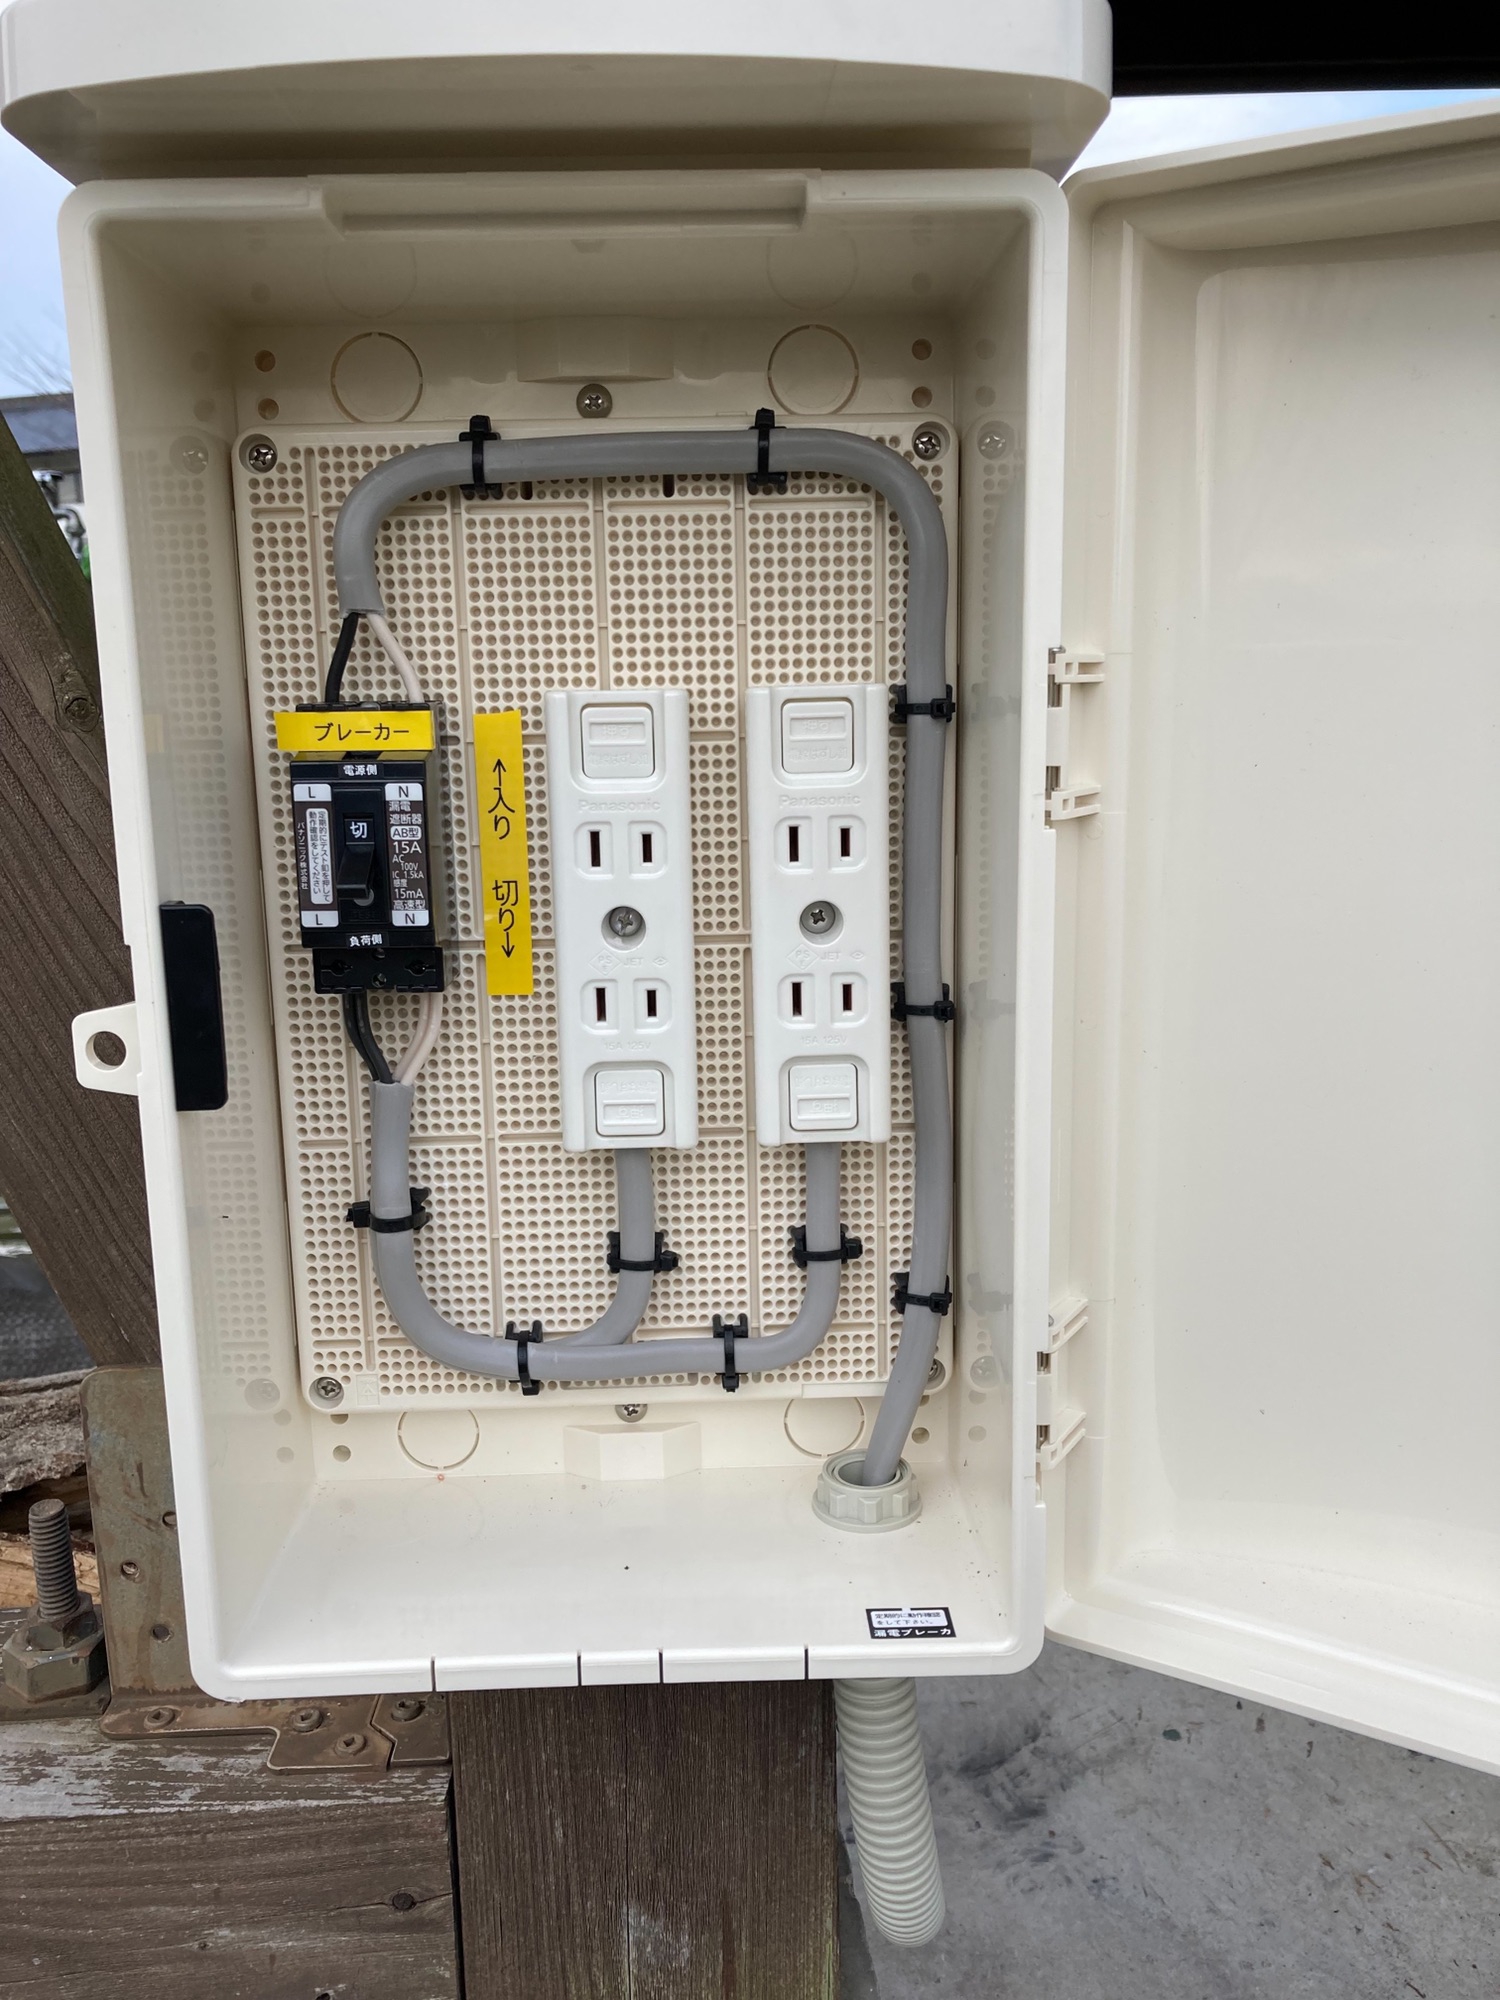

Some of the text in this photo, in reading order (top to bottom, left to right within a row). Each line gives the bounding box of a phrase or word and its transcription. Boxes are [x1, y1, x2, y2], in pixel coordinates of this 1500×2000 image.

[314, 722, 409, 741] ブレーカー
[343, 764, 378, 776] 電源側
[308, 786, 316, 798] L
[398, 786, 409, 798] N
[389, 801, 411, 812] 漏電
[578, 799, 661, 814] Panasonic
[779, 793, 861, 809] Panasonic
[488, 787, 515, 840] 入り
[389, 814, 422, 825] 遮断器
[350, 821, 368, 838] 切
[392, 828, 419, 838] AB型
[393, 842, 422, 854] 15A
[297, 823, 308, 890] パナソニック株式会社
[392, 855, 404, 863] AC
[401, 863, 418, 871] 100V
[393, 879, 408, 888] 感度
[394, 888, 424, 899] 15mA
[393, 900, 425, 910] 高速型
[492, 880, 518, 932] 切り
[315, 914, 323, 925] L
[405, 913, 415, 924] N
[350, 934, 383, 947] 負荷側
[623, 956, 644, 967] JET
[820, 951, 842, 961] JET
[823, 1034, 848, 1045] 125V
[627, 1040, 651, 1051] 125V
[874, 1628, 951, 1638] 漏電ブレーカ
